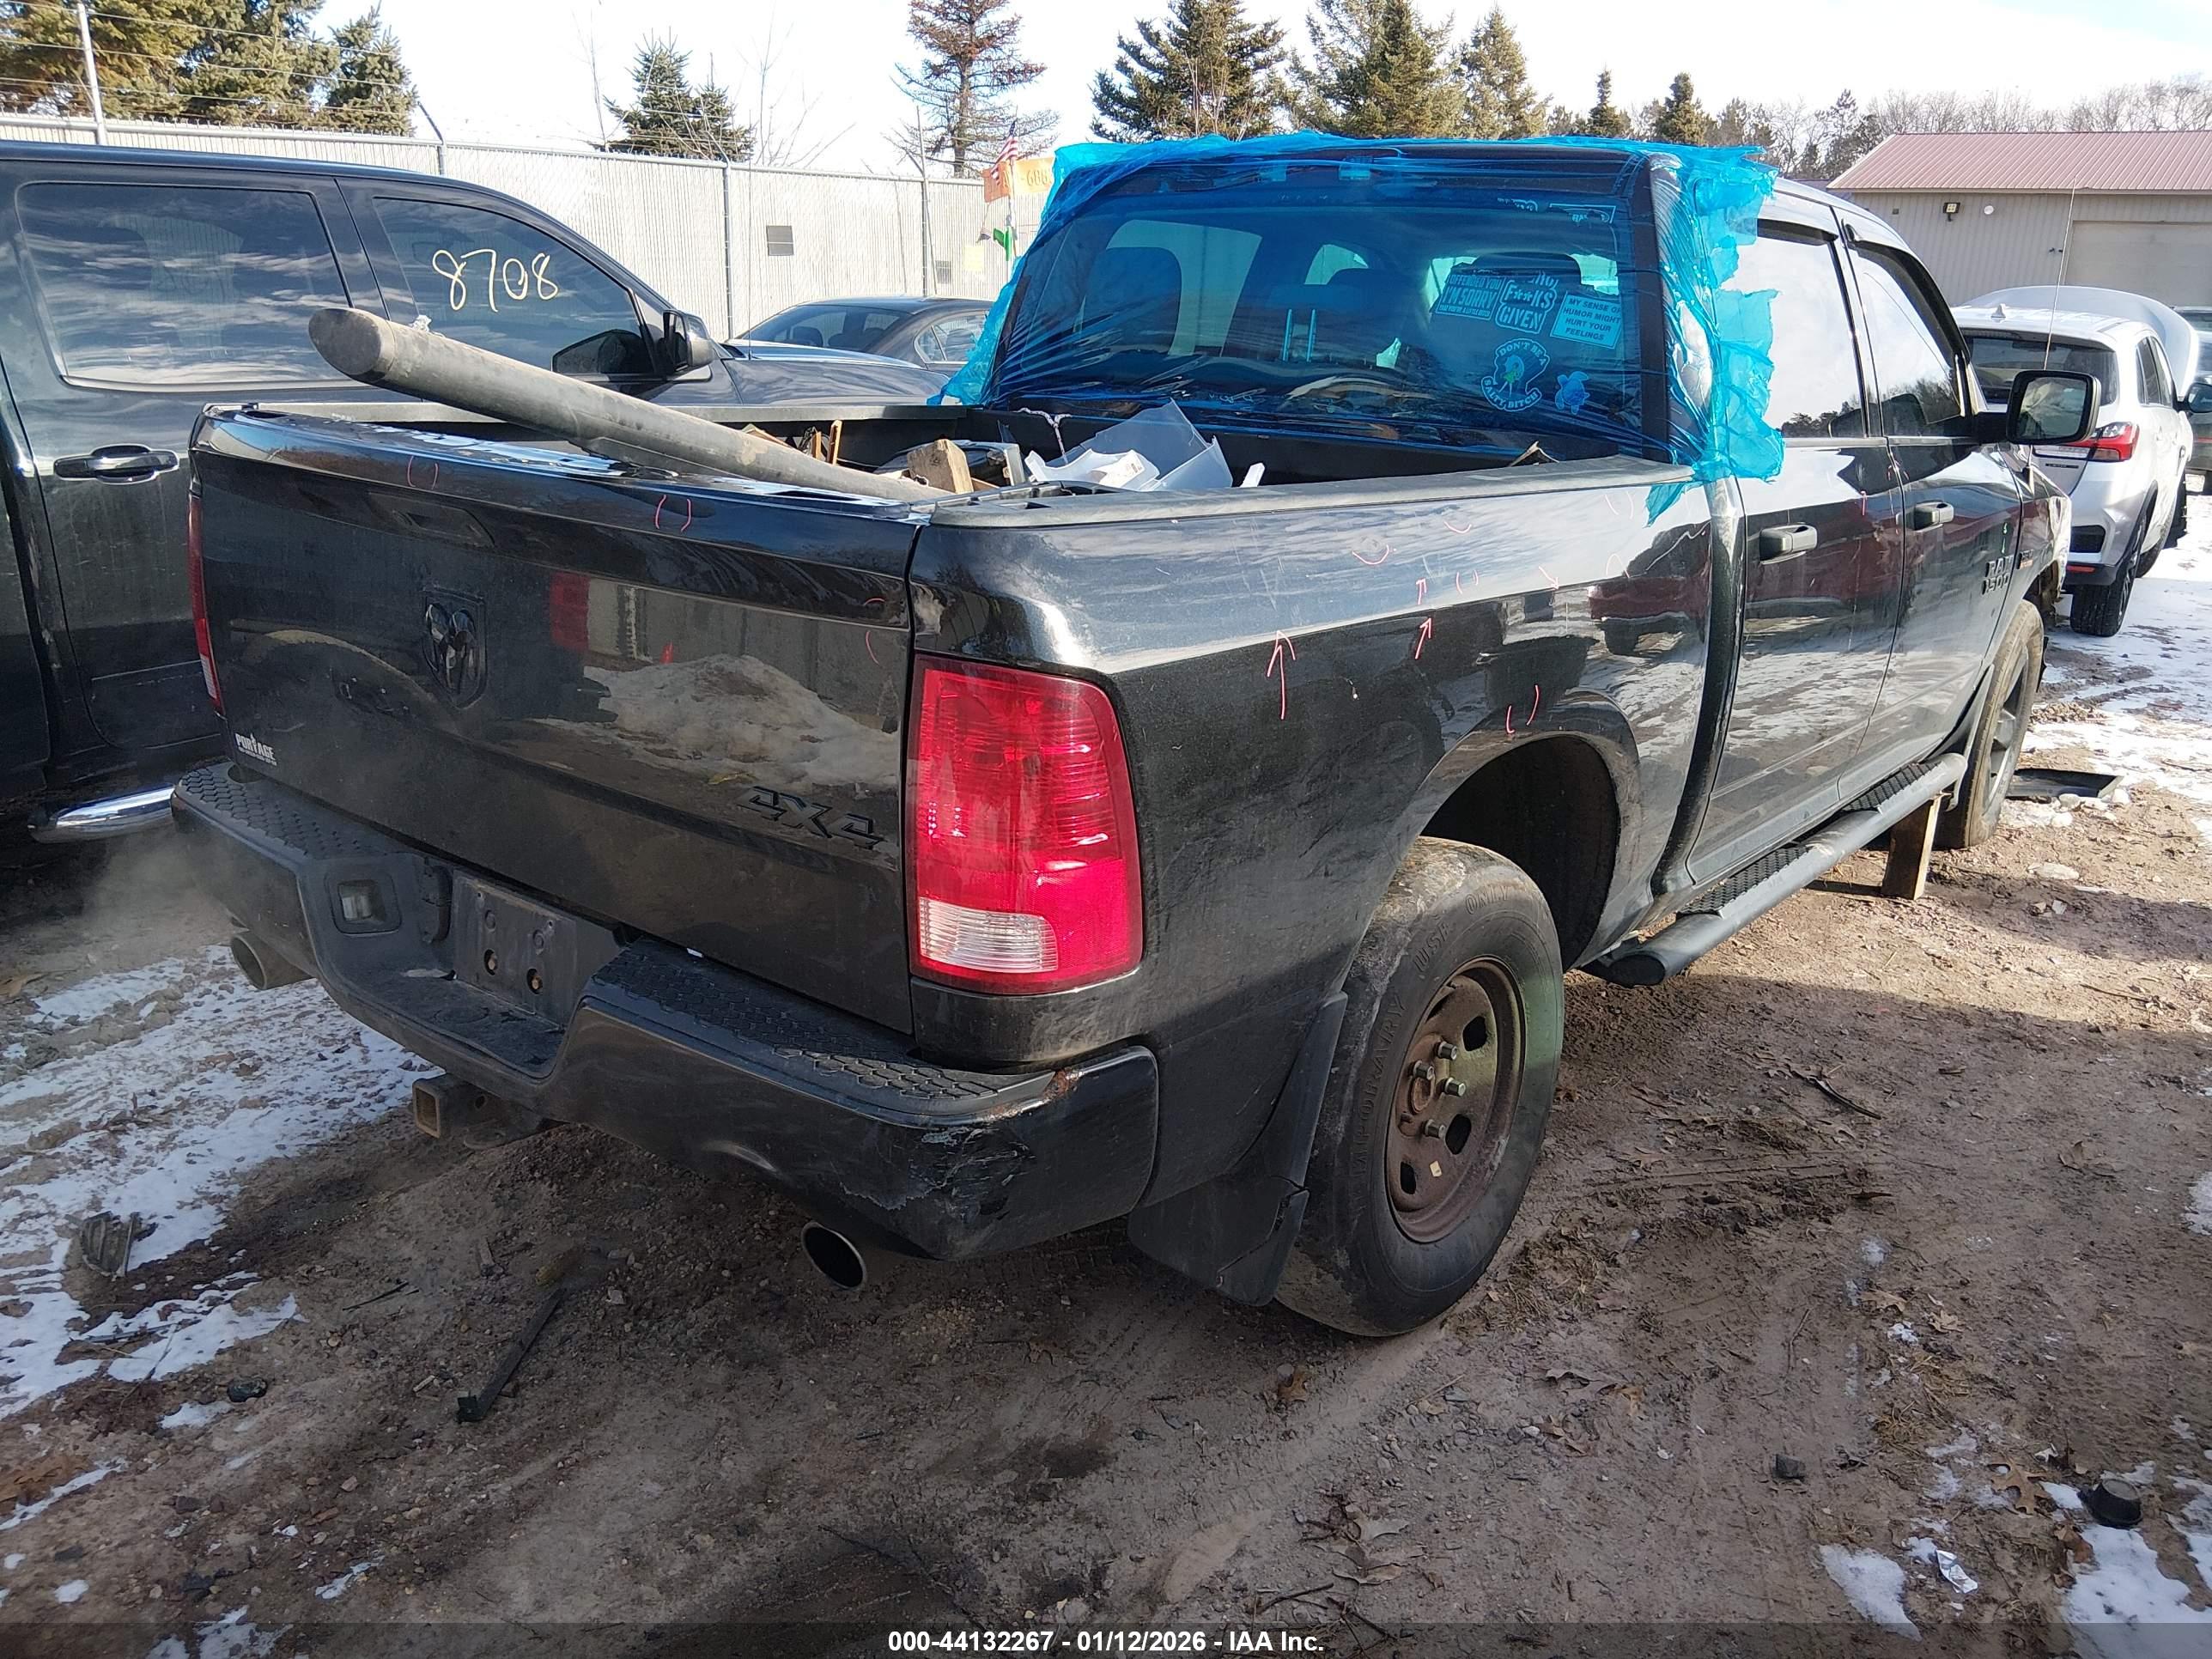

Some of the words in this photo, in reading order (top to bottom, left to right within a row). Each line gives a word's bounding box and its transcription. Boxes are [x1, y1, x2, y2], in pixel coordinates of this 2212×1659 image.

[432, 248, 558, 312] 8708
[1449, 274, 1486, 288] OFFENDED
[1485, 276, 1503, 290] YOU
[1442, 285, 1462, 304] I'M
[1459, 288, 1498, 309] SORRY
[1568, 297, 1582, 307] MY
[1582, 300, 1609, 312] SENSE
[1498, 304, 1543, 331] GIVEN
[1563, 307, 1593, 319] HUMOR
[1594, 313, 1622, 324] MIGHT
[1565, 317, 1588, 327] HURT
[1589, 321, 1612, 332] YOUR
[1565, 326, 1605, 341] FEELINGS
[1498, 341, 1530, 357] DON'T
[1530, 344, 1543, 358] BE
[1484, 379, 1506, 406] SALTY
[1507, 391, 1539, 409] BITCH
[1464, 884, 1510, 915] ONLY
